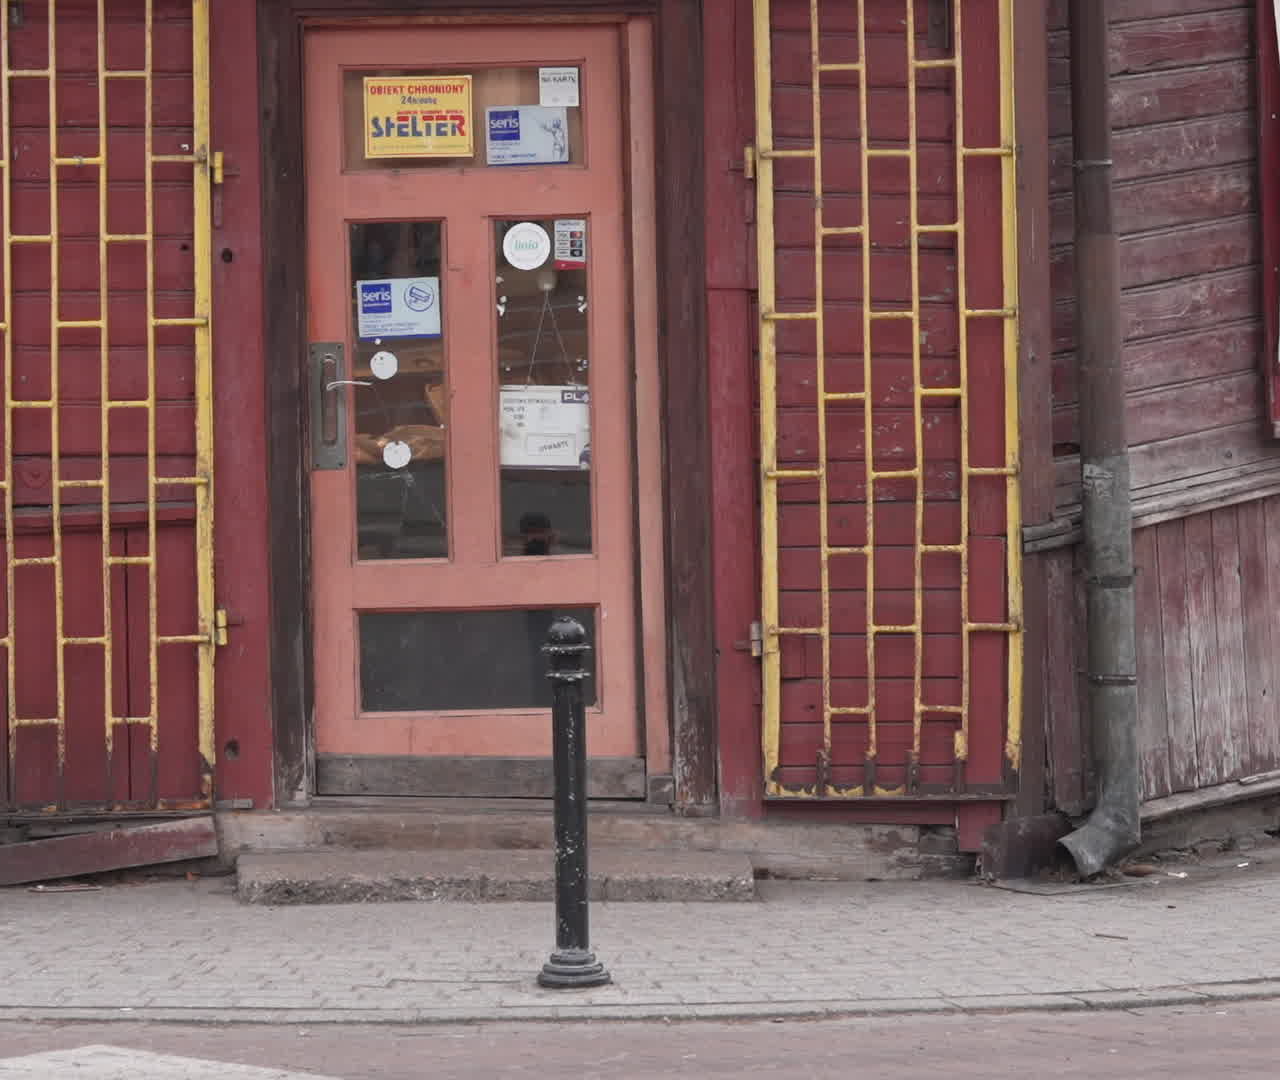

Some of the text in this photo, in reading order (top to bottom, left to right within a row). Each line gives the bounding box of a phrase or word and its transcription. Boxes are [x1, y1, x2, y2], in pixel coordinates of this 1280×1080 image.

[370, 84, 465, 96] OBIEKT CHRONIONY
[490, 115, 519, 130] seris
[363, 288, 391, 302] seris
